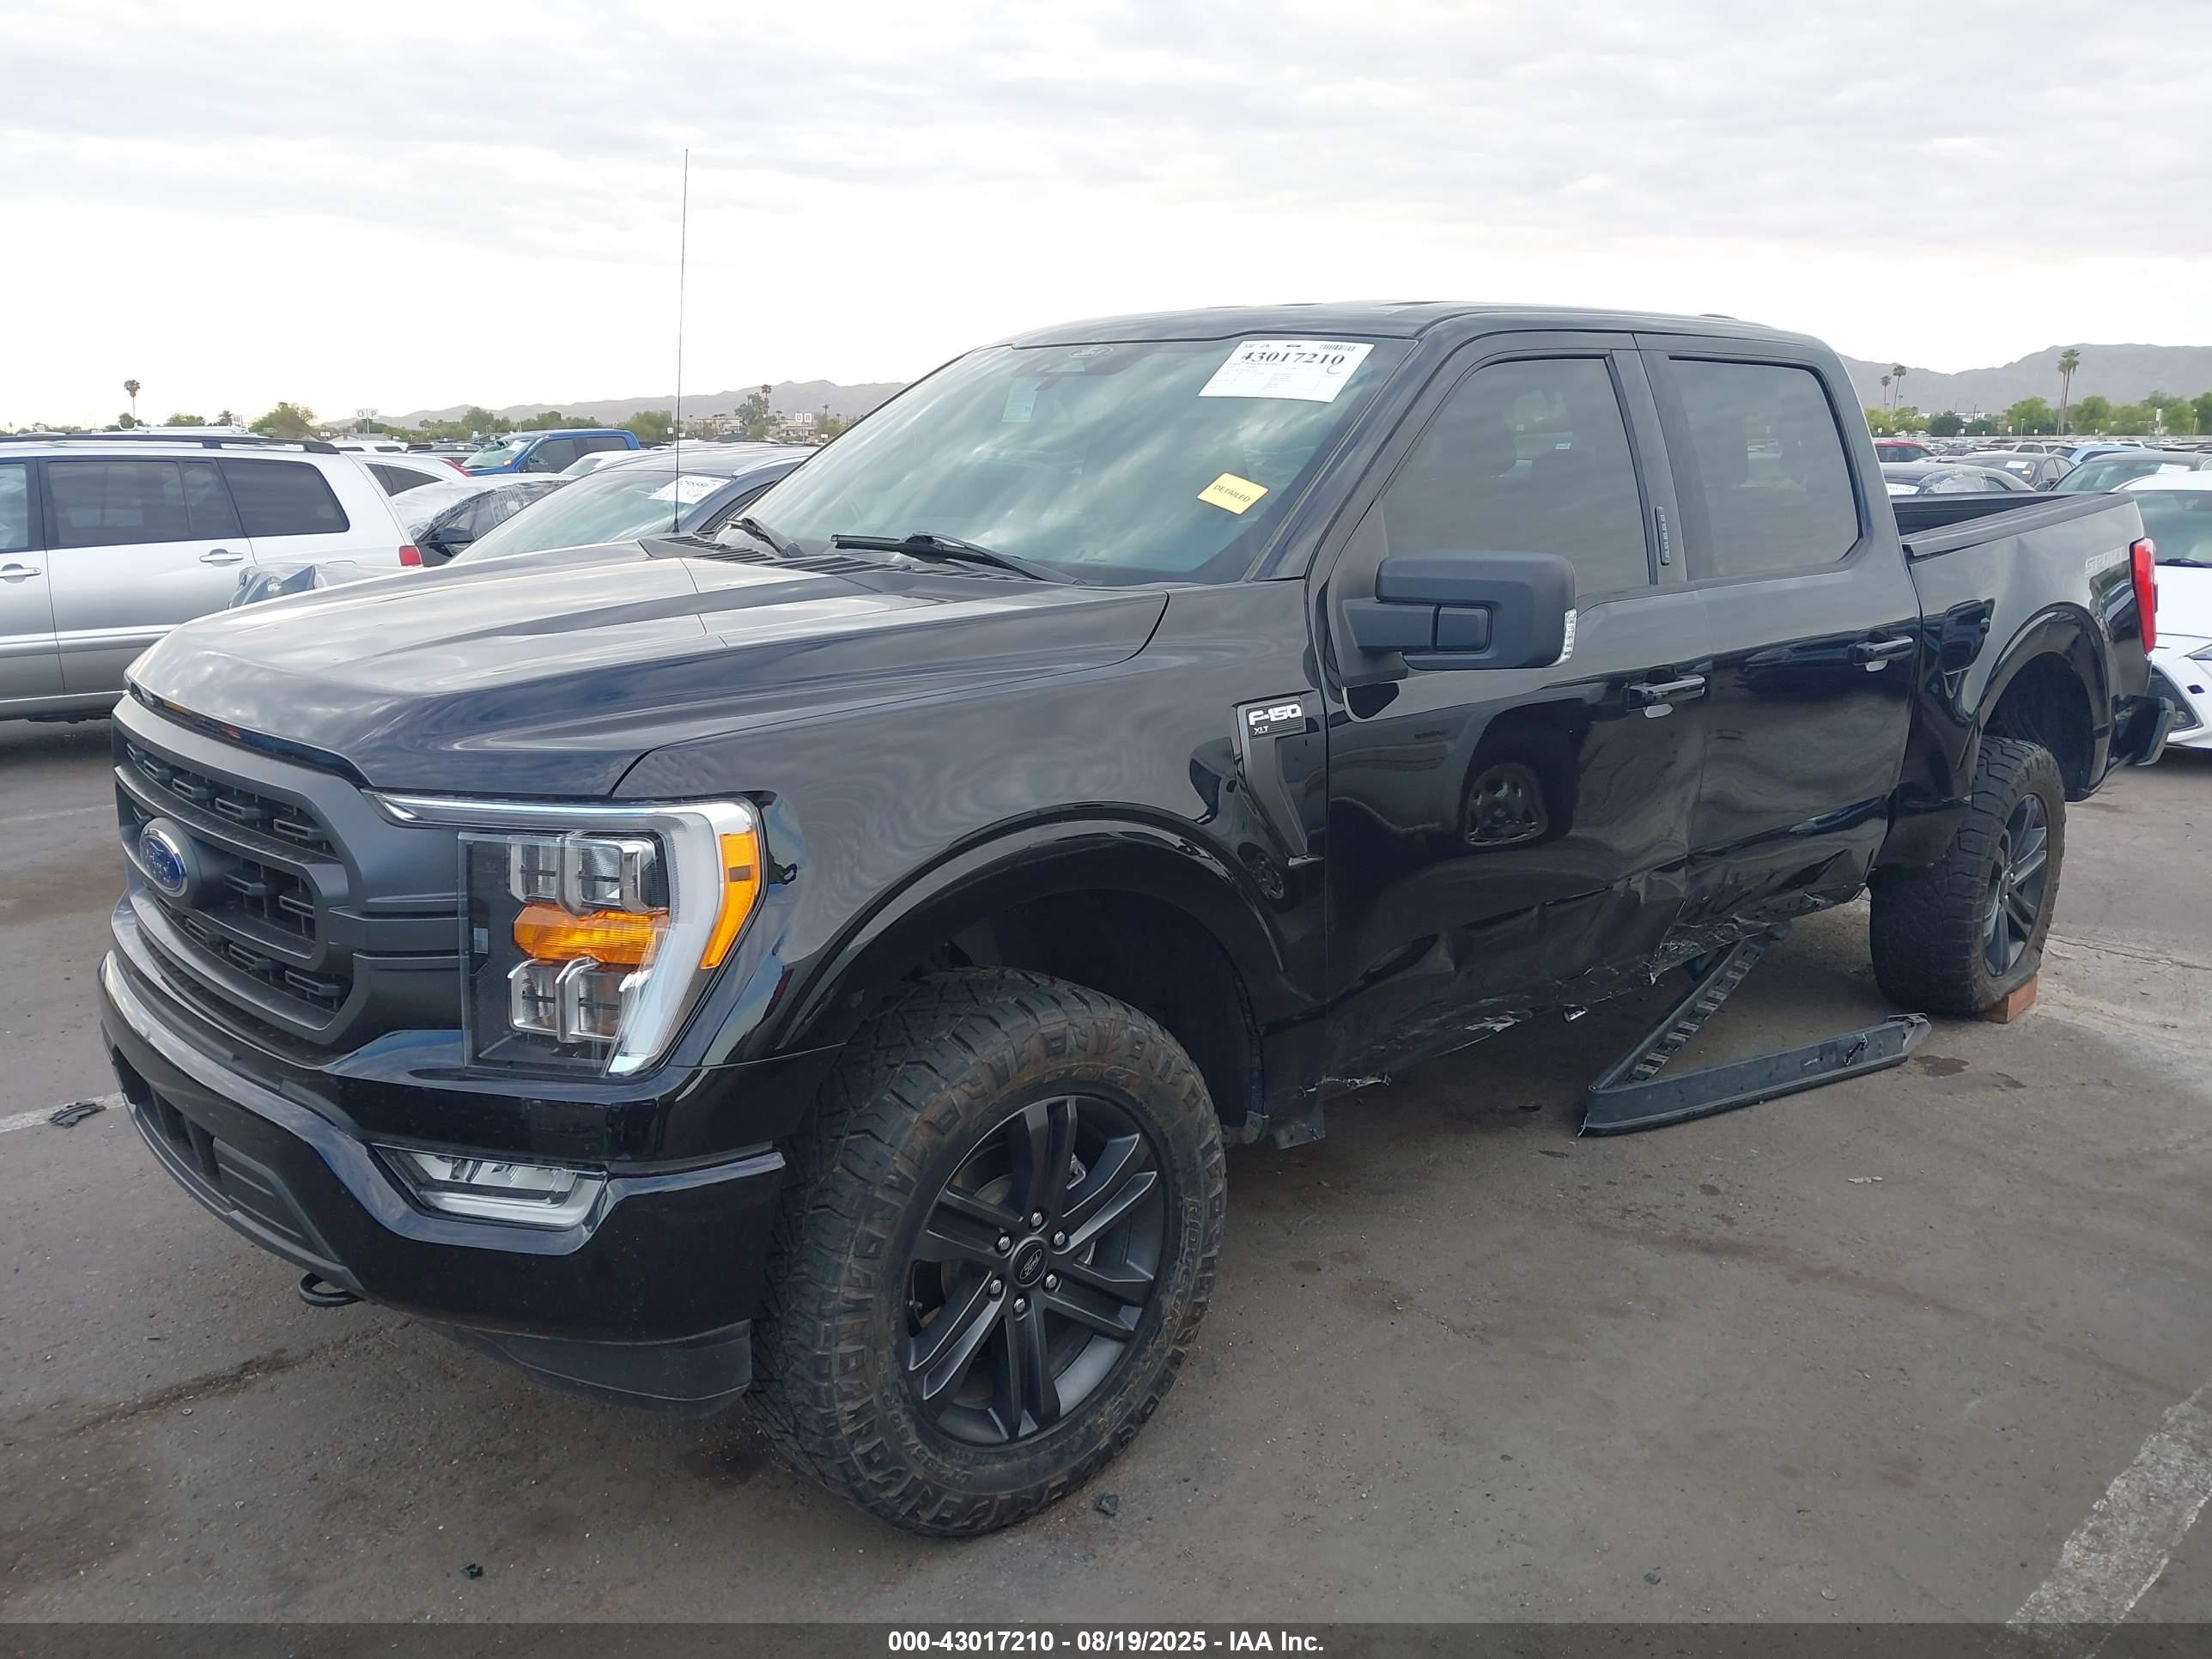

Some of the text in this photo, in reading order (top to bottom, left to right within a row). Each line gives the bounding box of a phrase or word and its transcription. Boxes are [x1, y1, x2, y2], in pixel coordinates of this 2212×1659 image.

[1242, 351, 1346, 365] 43017210
[1212, 484, 1251, 502] DETAILED
[1248, 703, 1303, 726] F-150
[1253, 725, 1270, 735] XLT
